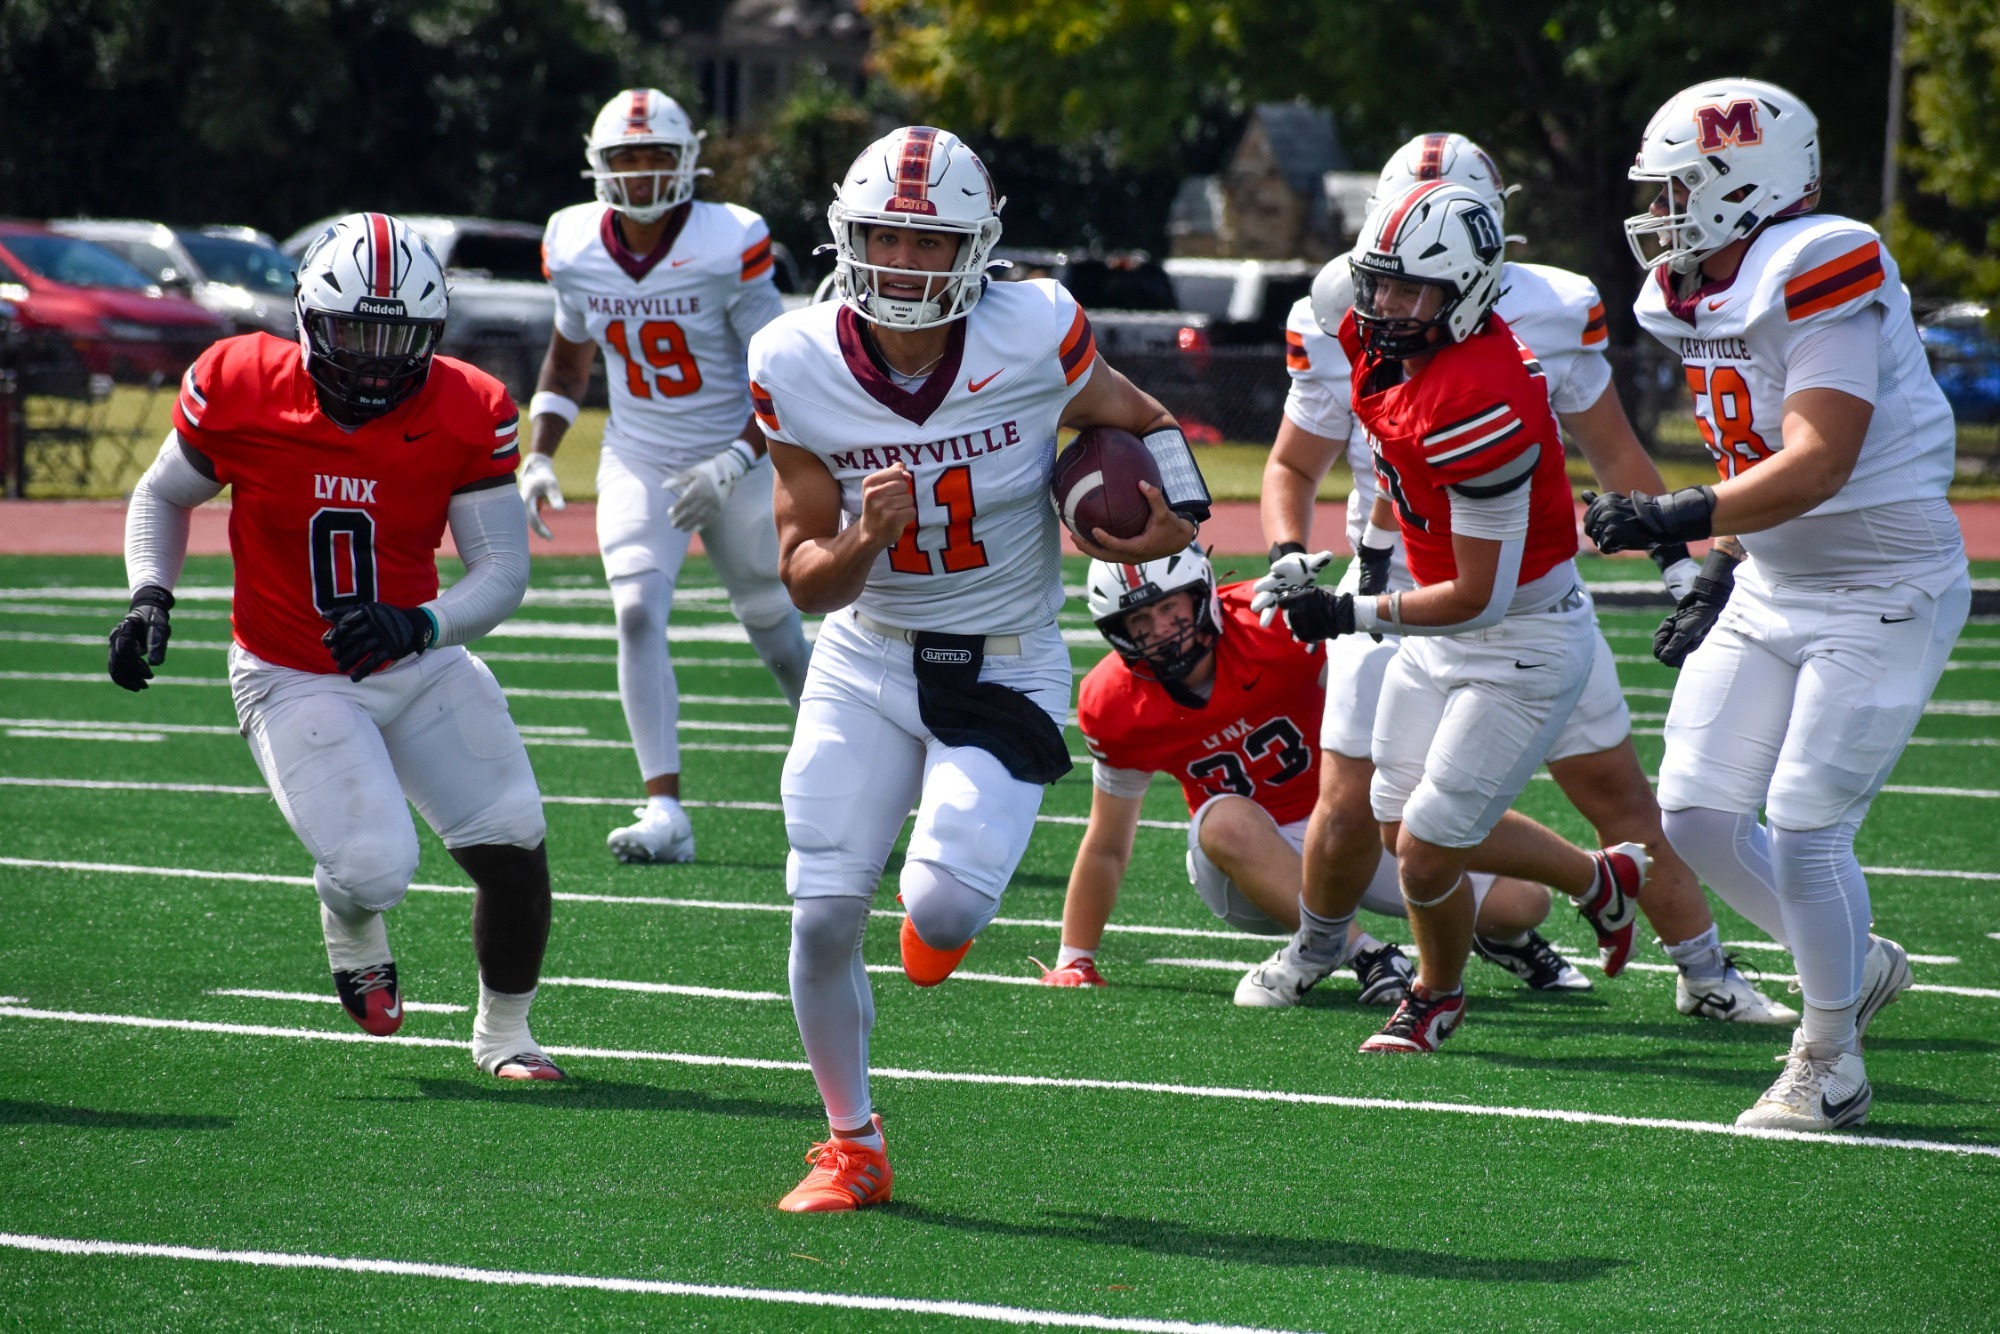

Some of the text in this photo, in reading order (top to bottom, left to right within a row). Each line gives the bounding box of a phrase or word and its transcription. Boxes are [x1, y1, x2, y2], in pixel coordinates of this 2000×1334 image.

[1693, 99, 1762, 154] M
[1364, 254, 1399, 270] Riddell
[359, 302, 404, 316] Riddell
[587, 296, 701, 317] MARYVILLE
[890, 305, 913, 313] Riddell
[605, 319, 703, 399] 19
[1682, 363, 1778, 482] 58
[830, 420, 1021, 470] MARYVILLE
[314, 474, 378, 504] LYNX
[887, 464, 989, 576] 11
[308, 506, 379, 617] 0
[925, 650, 968, 662] BATTLE
[1202, 717, 1255, 750] LYNX
[1186, 715, 1312, 797] 33
